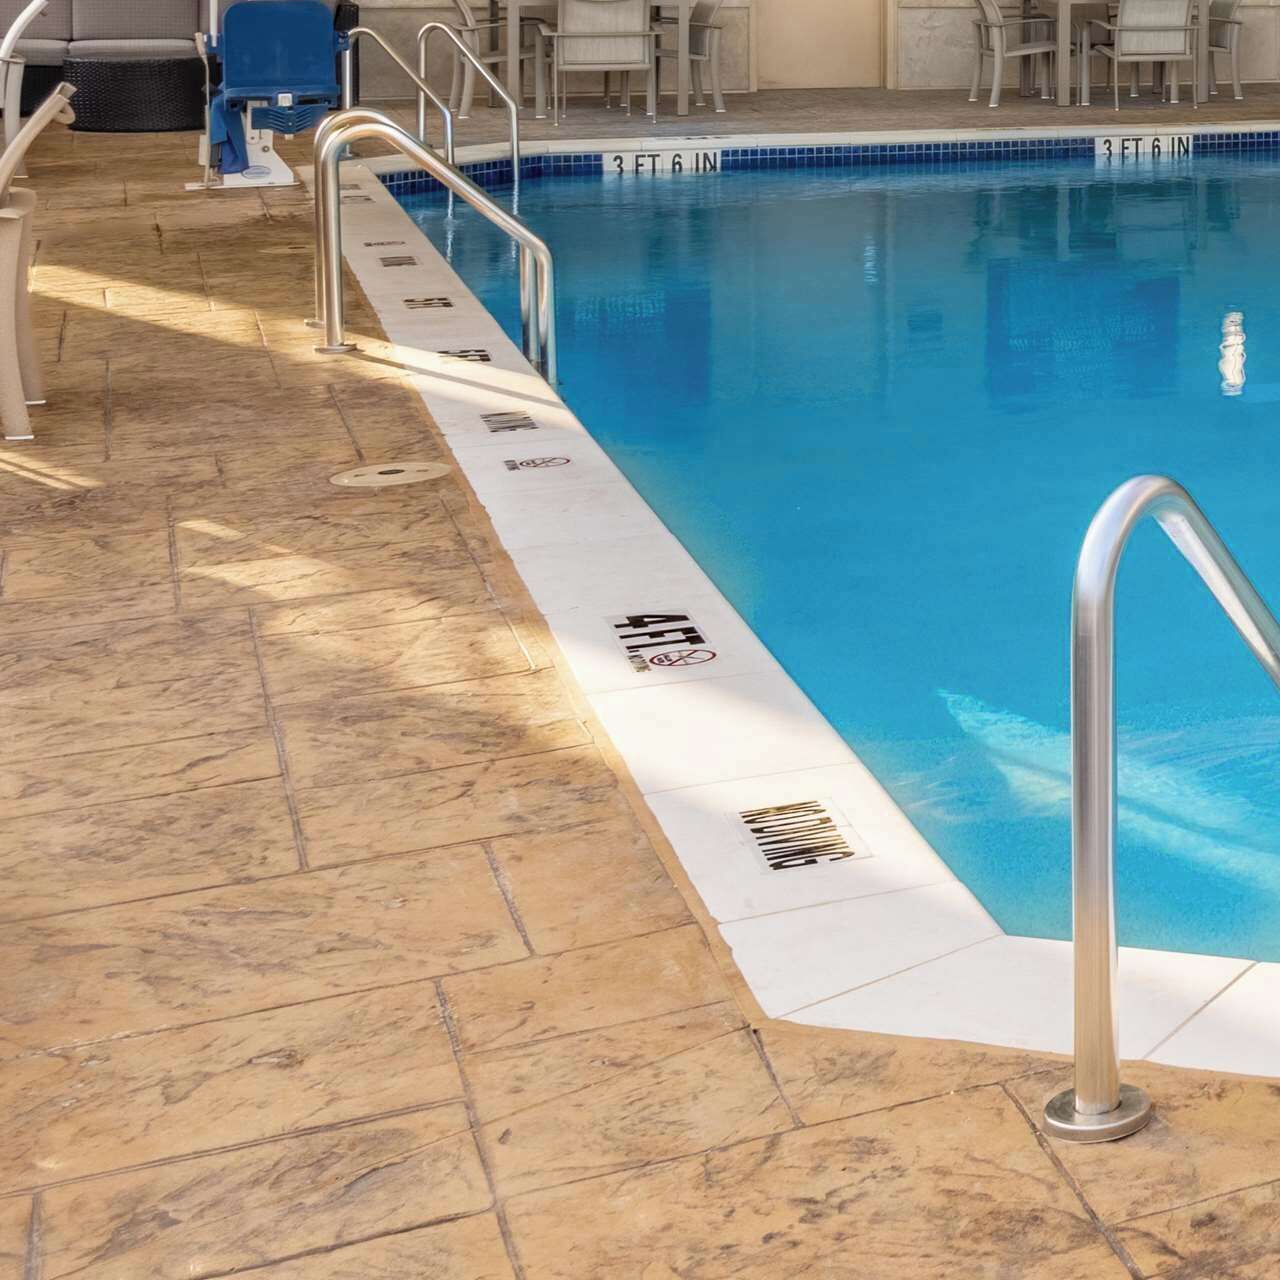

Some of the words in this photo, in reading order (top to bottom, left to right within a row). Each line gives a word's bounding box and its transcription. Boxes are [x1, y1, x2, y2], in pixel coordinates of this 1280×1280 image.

[1104, 139, 1112, 156] 3
[1121, 137, 1143, 157] FT
[1152, 137, 1160, 156] 6
[1171, 136, 1189, 156] IN
[613, 155, 624, 174] 3
[635, 154, 660, 174] FT
[672, 153, 682, 172] 6
[695, 152, 717, 172] IN
